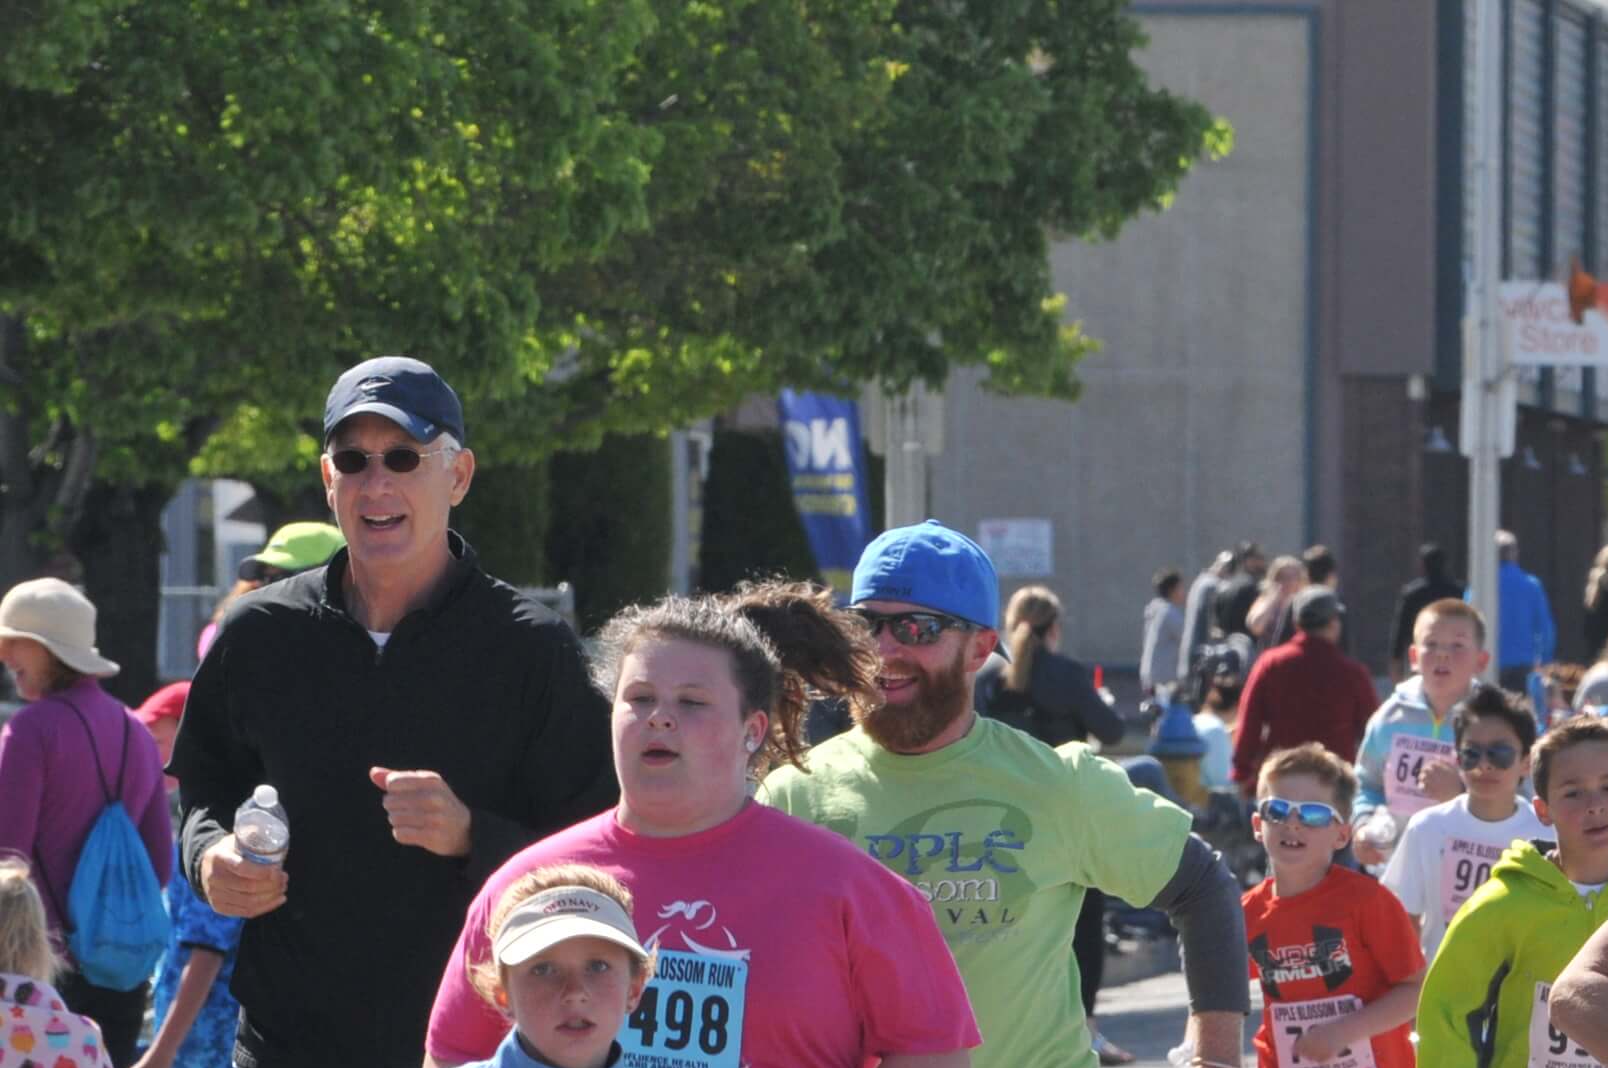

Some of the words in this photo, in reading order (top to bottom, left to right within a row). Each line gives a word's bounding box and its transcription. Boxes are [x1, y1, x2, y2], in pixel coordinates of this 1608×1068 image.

[1396, 753, 1424, 786] 64
[864, 829, 1024, 876] PPLE
[568, 897, 601, 912] NAVY
[655, 956, 705, 985] OSSOM
[708, 962, 735, 989] RUN
[628, 986, 729, 1056] 498
[1274, 1005, 1297, 1021] APPLE
[1296, 1000, 1337, 1021] BLOSSOM
